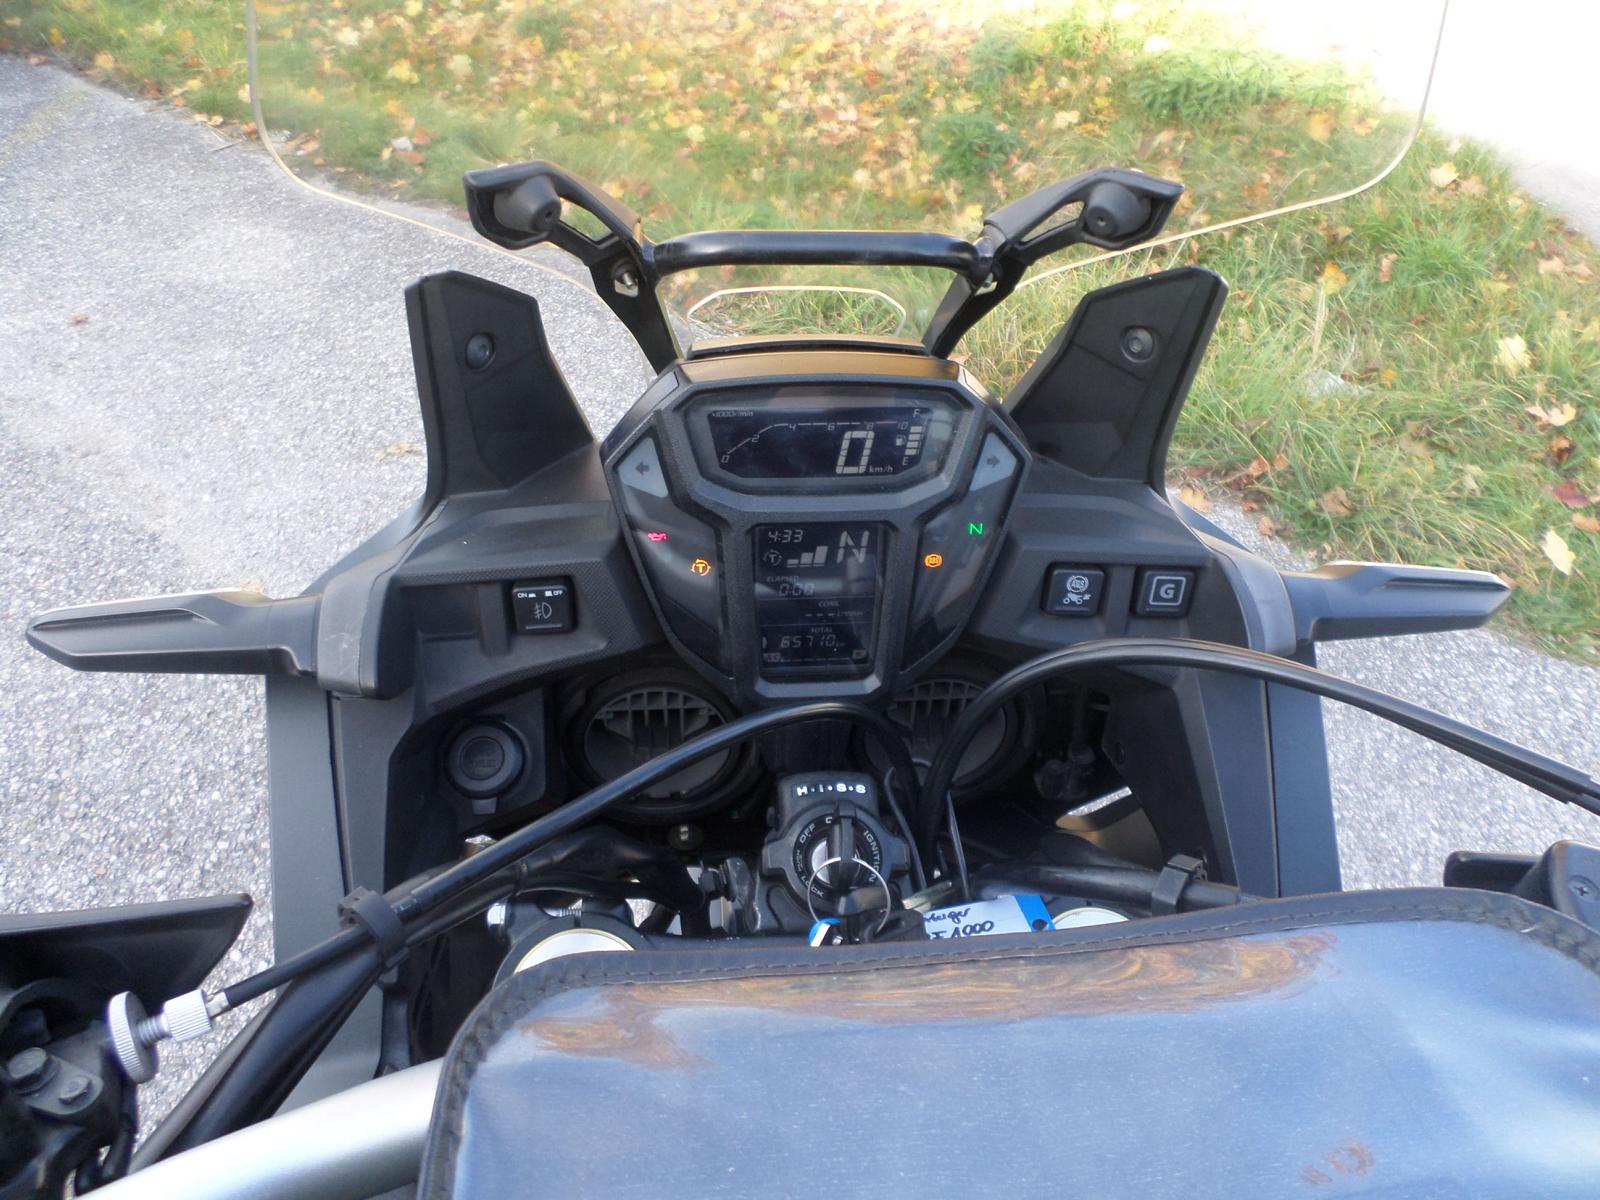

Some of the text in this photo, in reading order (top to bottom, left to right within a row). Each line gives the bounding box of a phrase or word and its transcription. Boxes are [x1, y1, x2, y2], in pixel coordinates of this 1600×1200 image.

[913, 408, 920, 418] F
[788, 423, 797, 431] 4
[827, 422, 836, 431] 6
[751, 434, 760, 443] 2
[835, 430, 894, 474] 0 km/h
[721, 454, 730, 464] 0
[902, 456, 909, 466] E
[969, 522, 983, 535] N
[768, 529, 803, 543] 4:33
[836, 530, 870, 564] N
[1159, 583, 1175, 599] G
[799, 823, 816, 844] OFF
